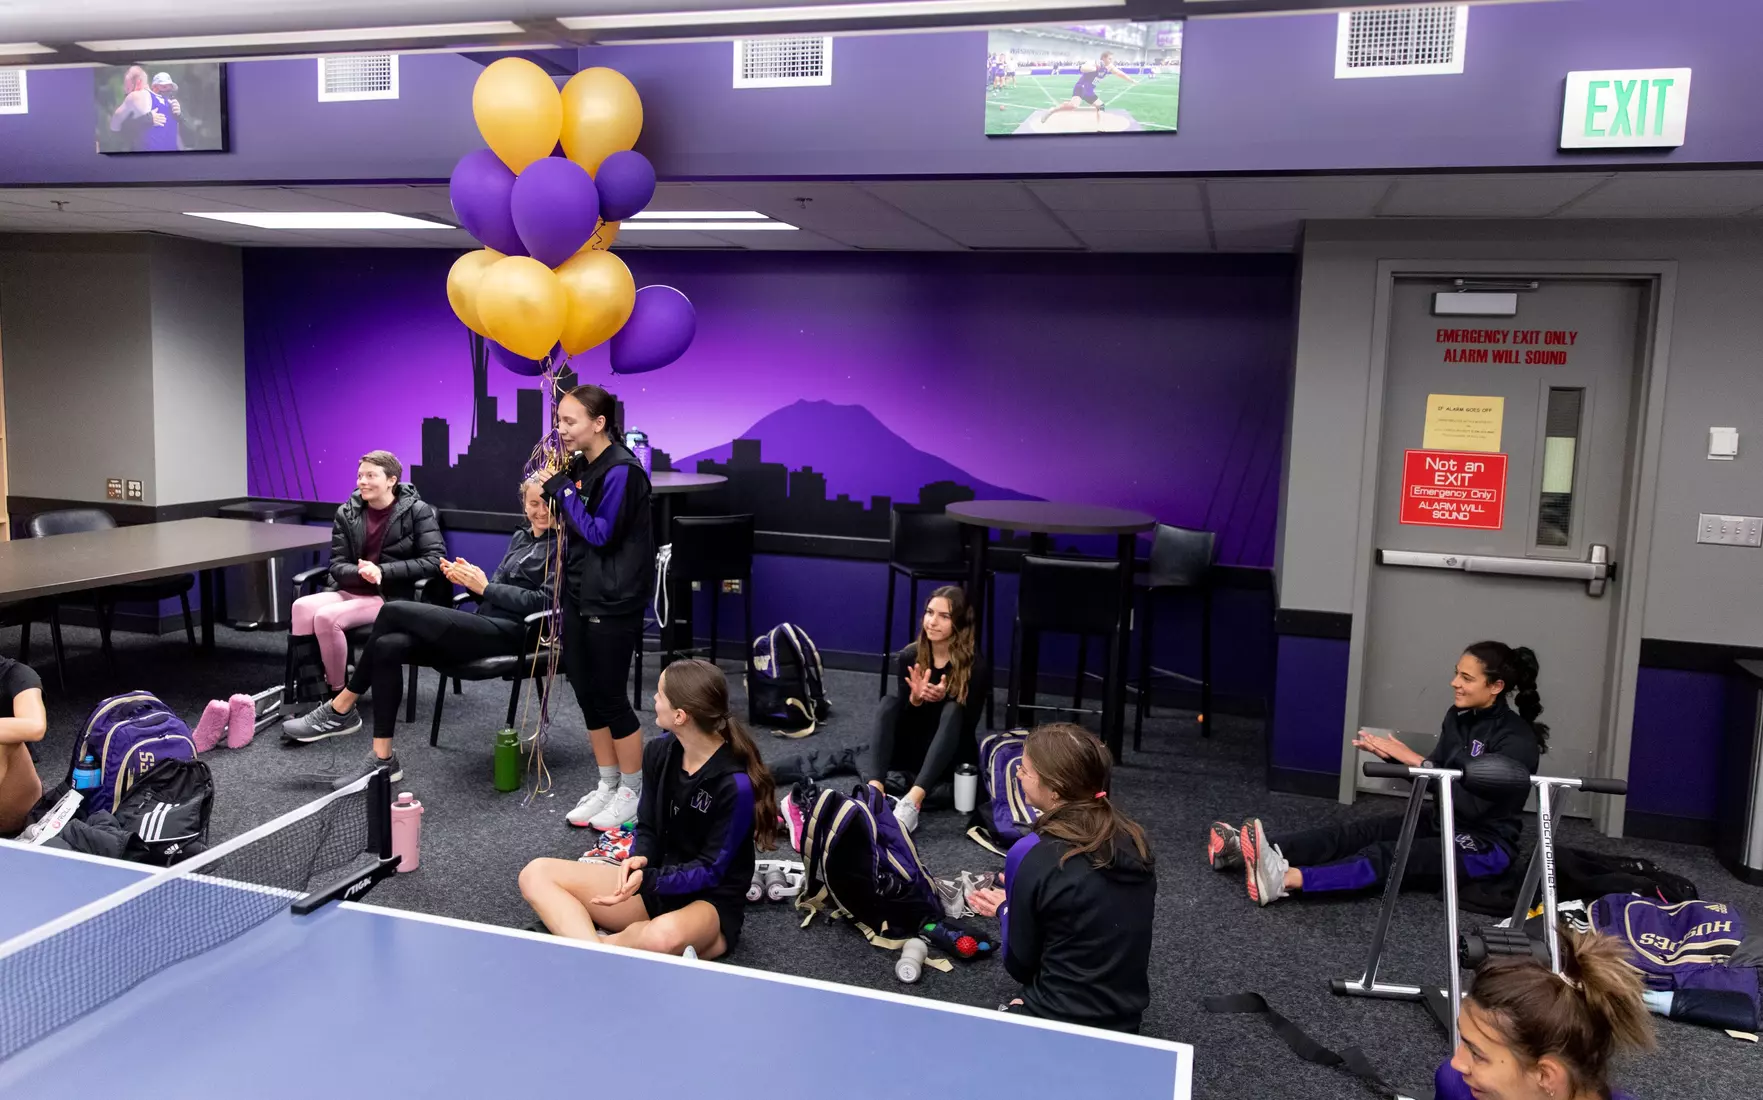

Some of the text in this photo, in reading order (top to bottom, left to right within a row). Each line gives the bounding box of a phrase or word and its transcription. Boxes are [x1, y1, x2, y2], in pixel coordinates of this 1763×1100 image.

[1584, 79, 1674, 137] EXIT
[1436, 329, 1578, 345] EMERGENCY EXIT ONLY
[1443, 349, 1567, 365] ALARM WILL SOUND
[1425, 457, 1485, 473] Not an
[1434, 471, 1473, 486] EXIT
[1413, 486, 1492, 500] Emergency Only
[1418, 500, 1485, 513] ALARM WILL
[1432, 510, 1470, 520] SOUND
